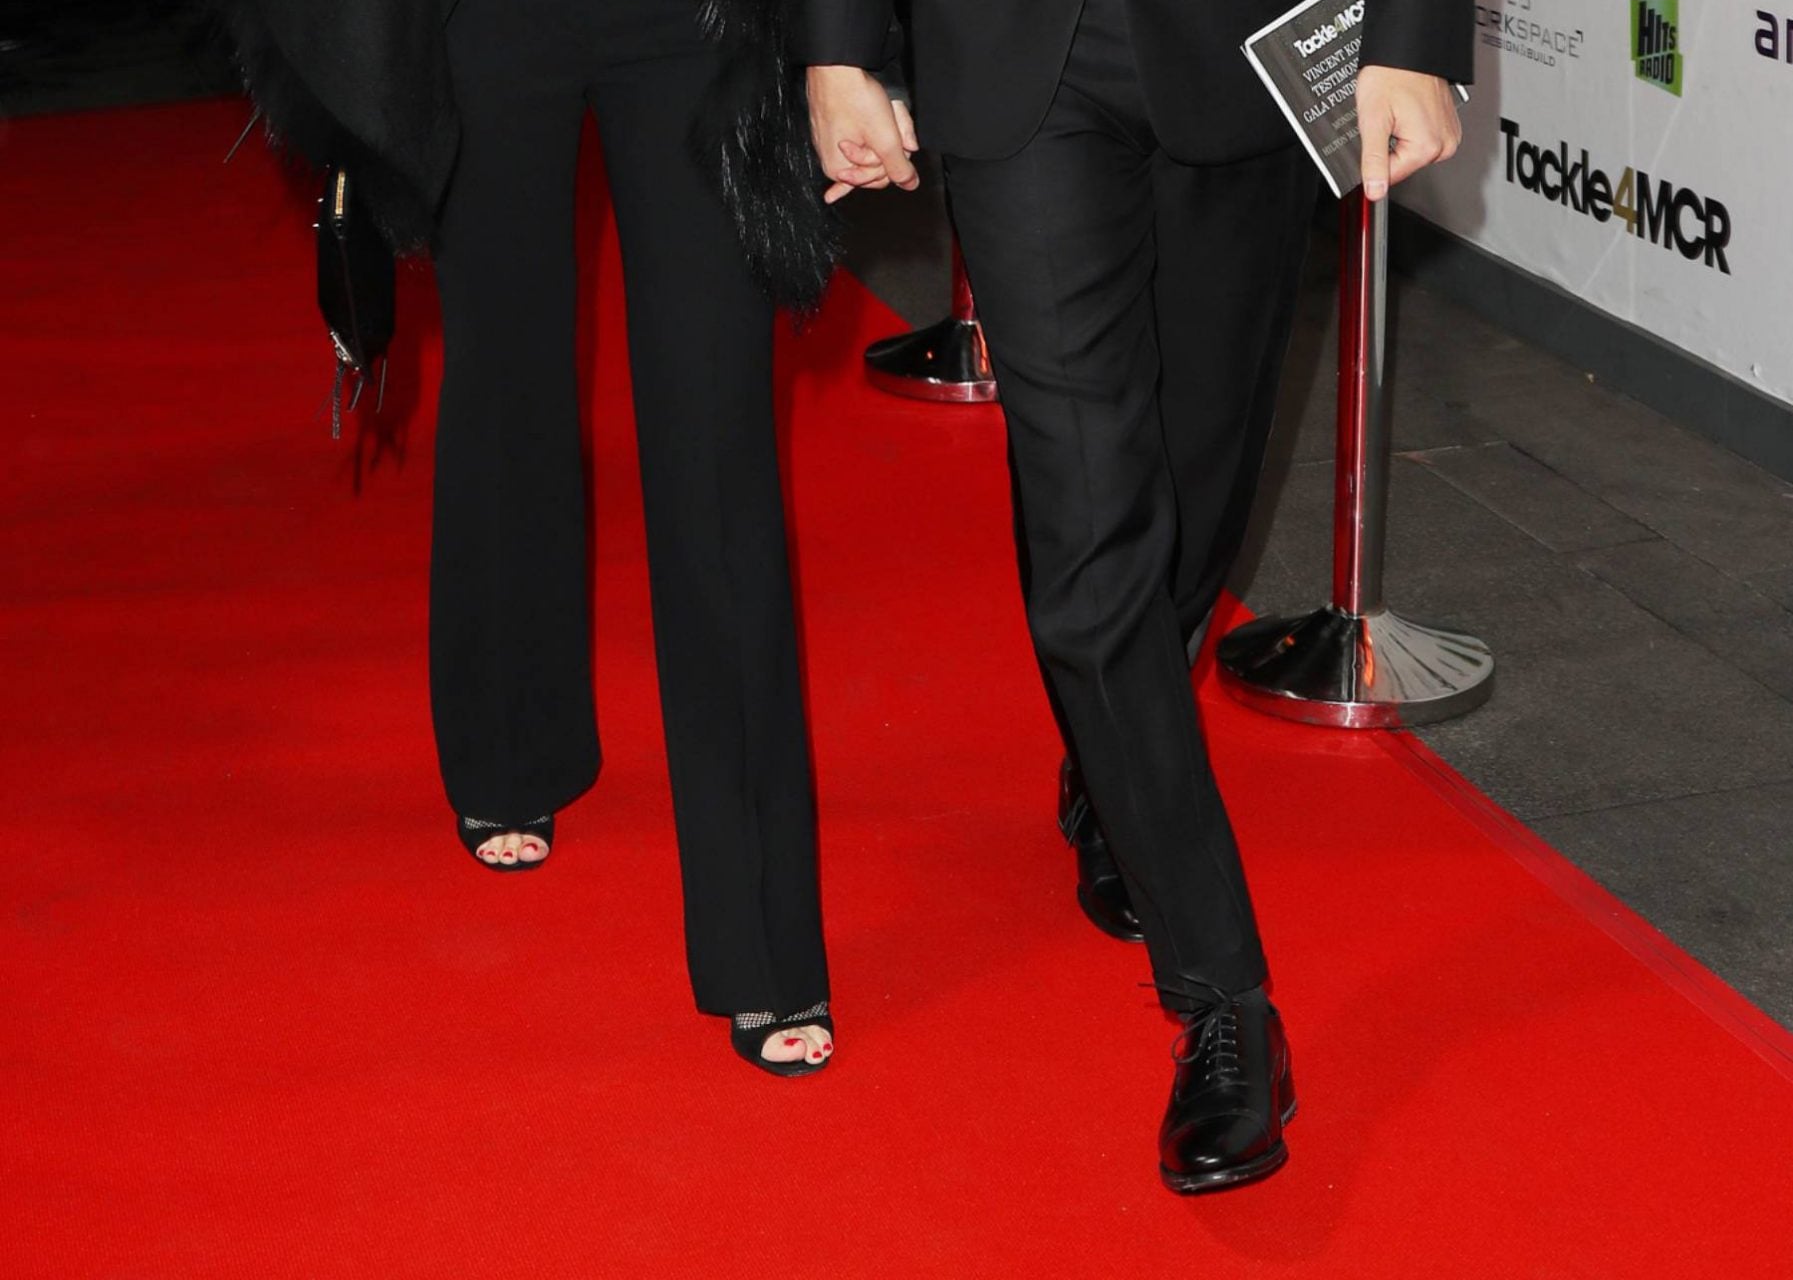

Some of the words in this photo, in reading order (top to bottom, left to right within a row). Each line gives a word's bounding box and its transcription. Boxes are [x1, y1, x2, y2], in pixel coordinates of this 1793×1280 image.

[1476, 5, 1580, 59] ORKSPACE
[1302, 48, 1346, 83] VINCENT
[1303, 100, 1330, 123] GALA
[1500, 117, 1731, 276] Tackle4MCR
